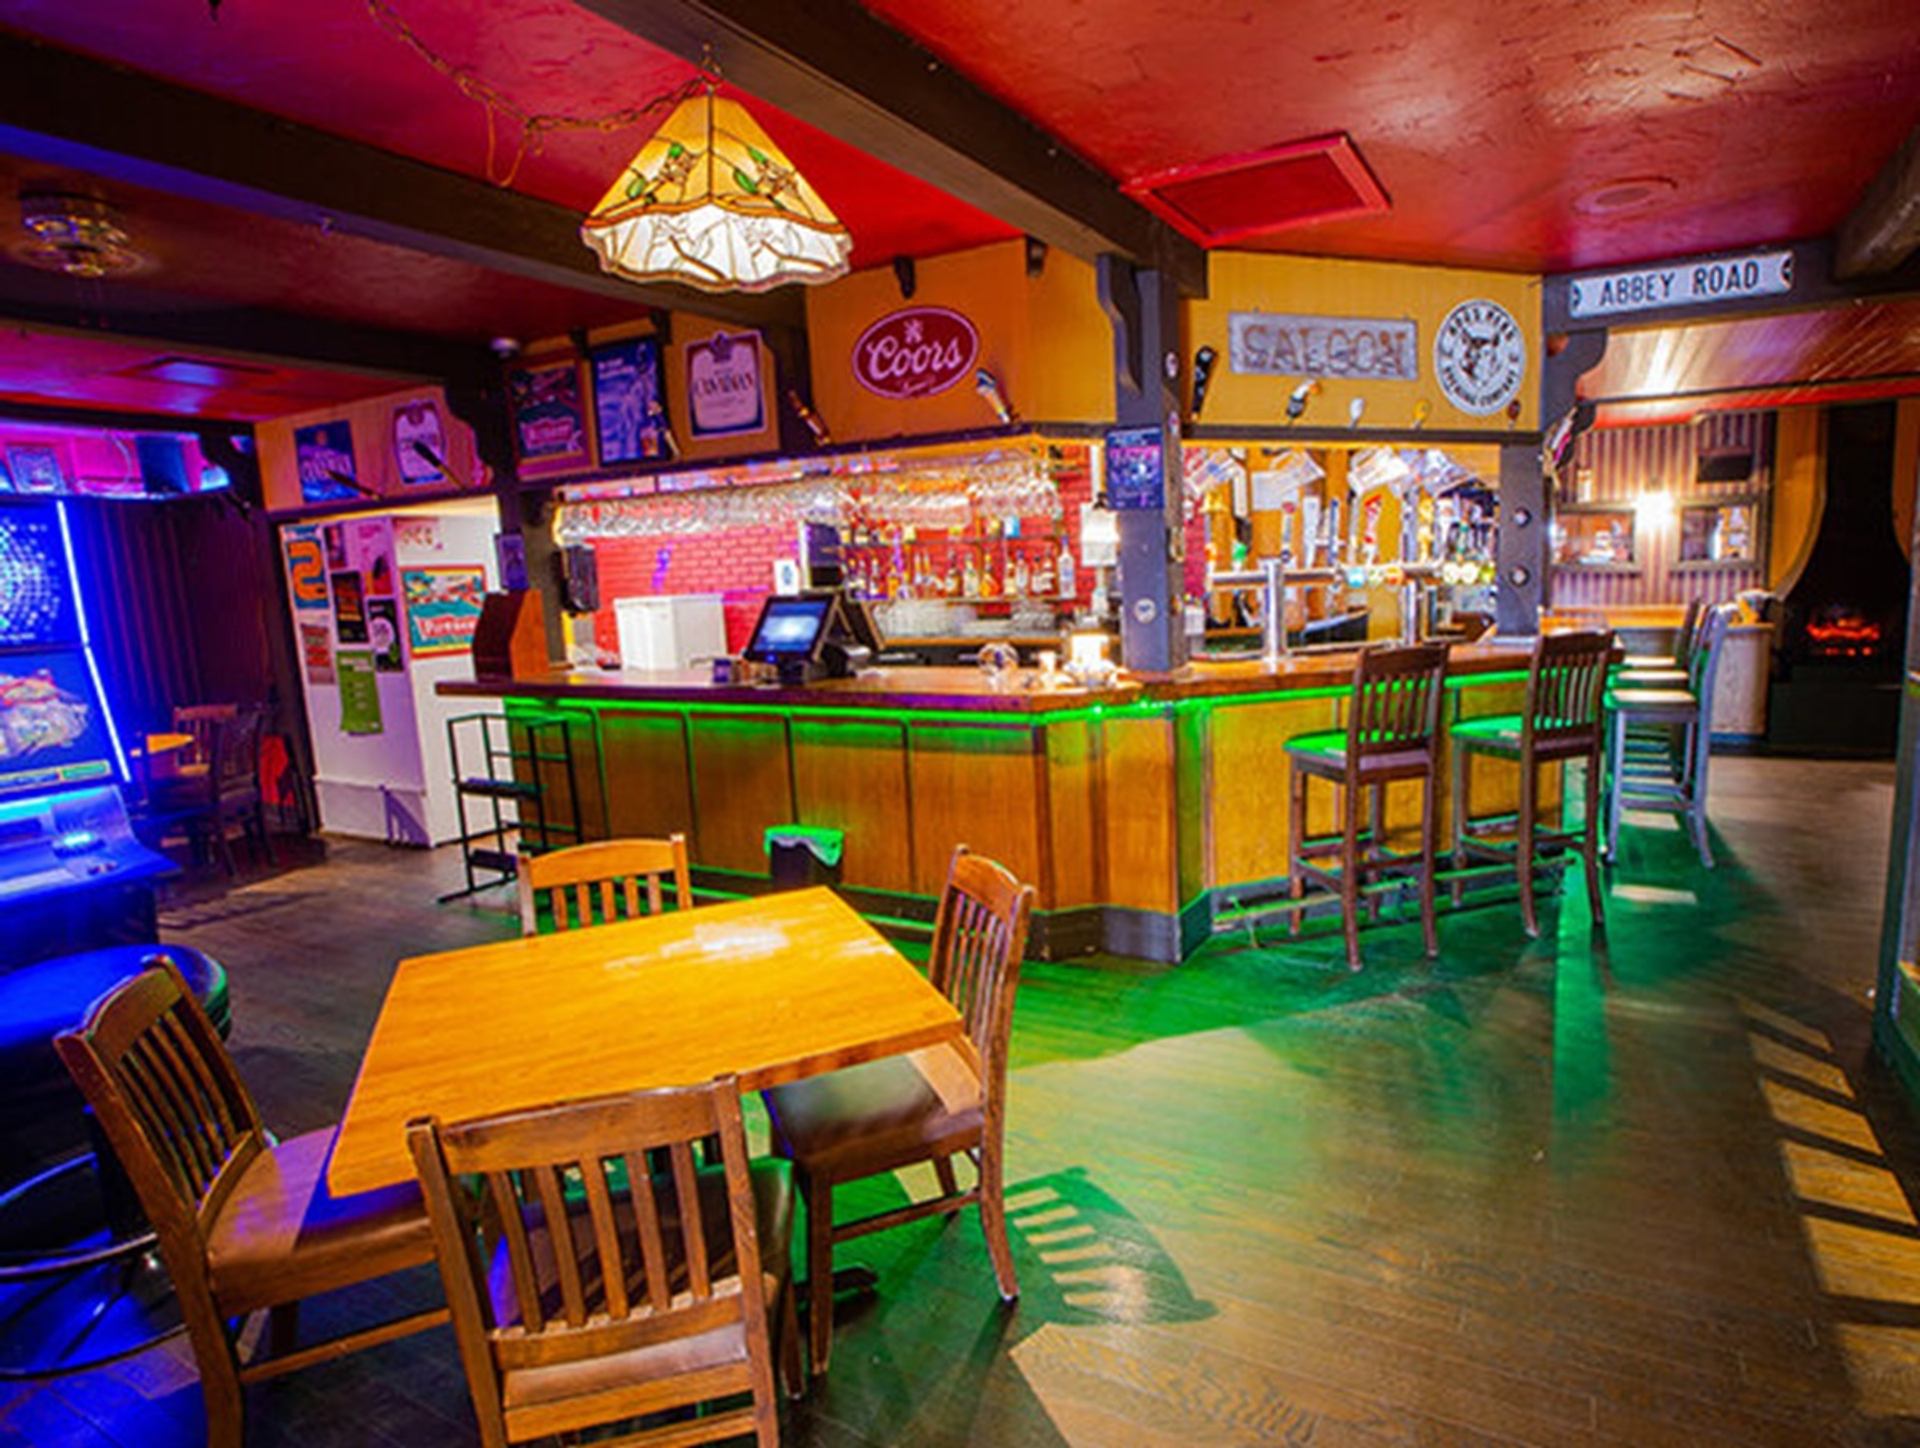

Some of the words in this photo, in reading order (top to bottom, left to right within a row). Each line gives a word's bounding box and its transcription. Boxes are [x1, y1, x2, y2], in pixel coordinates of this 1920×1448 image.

[1600, 271, 1676, 308] ABBEY
[1692, 260, 1760, 297] ROAD
[865, 335, 963, 381] Coors
[1243, 323, 1407, 377] SALOON
